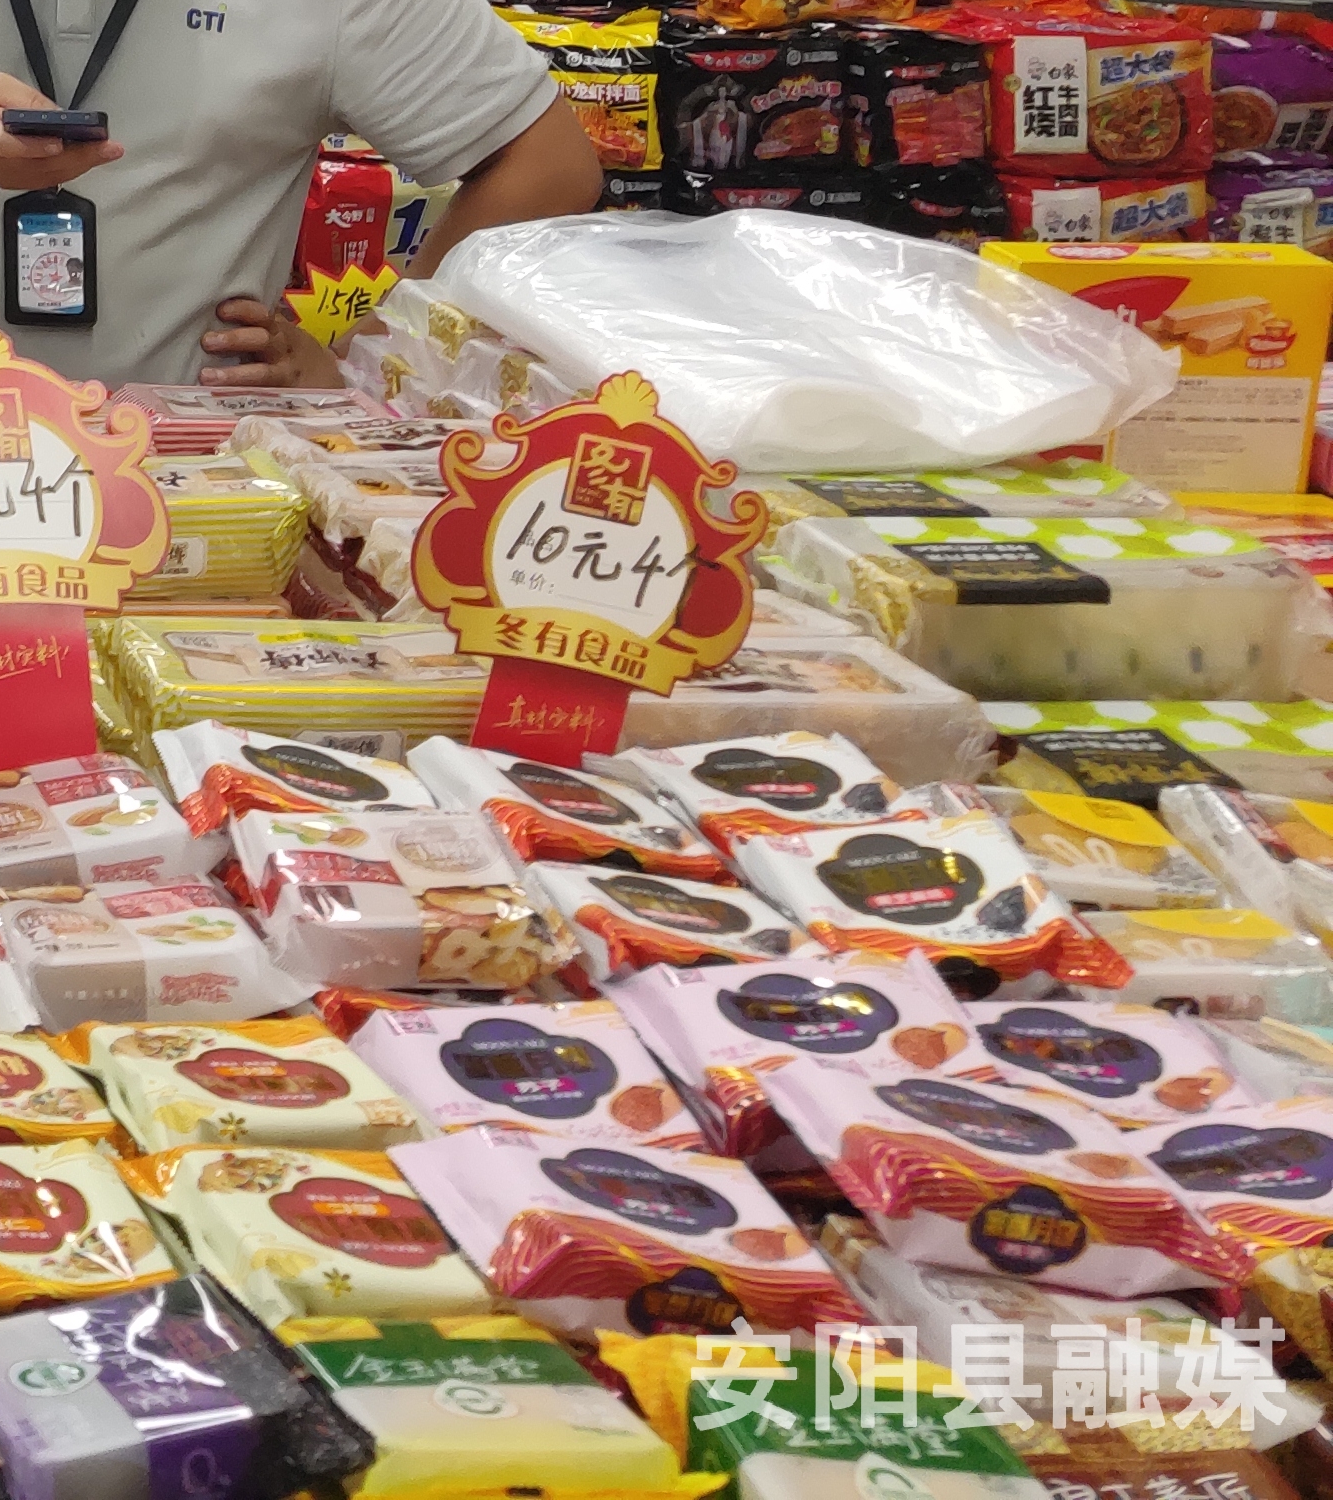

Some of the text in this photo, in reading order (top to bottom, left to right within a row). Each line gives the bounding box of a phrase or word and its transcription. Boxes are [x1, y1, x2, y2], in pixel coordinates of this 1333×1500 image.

[1100, 49, 1177, 86] 超大袋
[1023, 84, 1057, 139] 红烧
[1057, 84, 1081, 139] 牛肉面
[1111, 191, 1191, 235] 超大袋
[505, 500, 722, 630] 10元4个
[495, 613, 650, 680] 冬有食品
